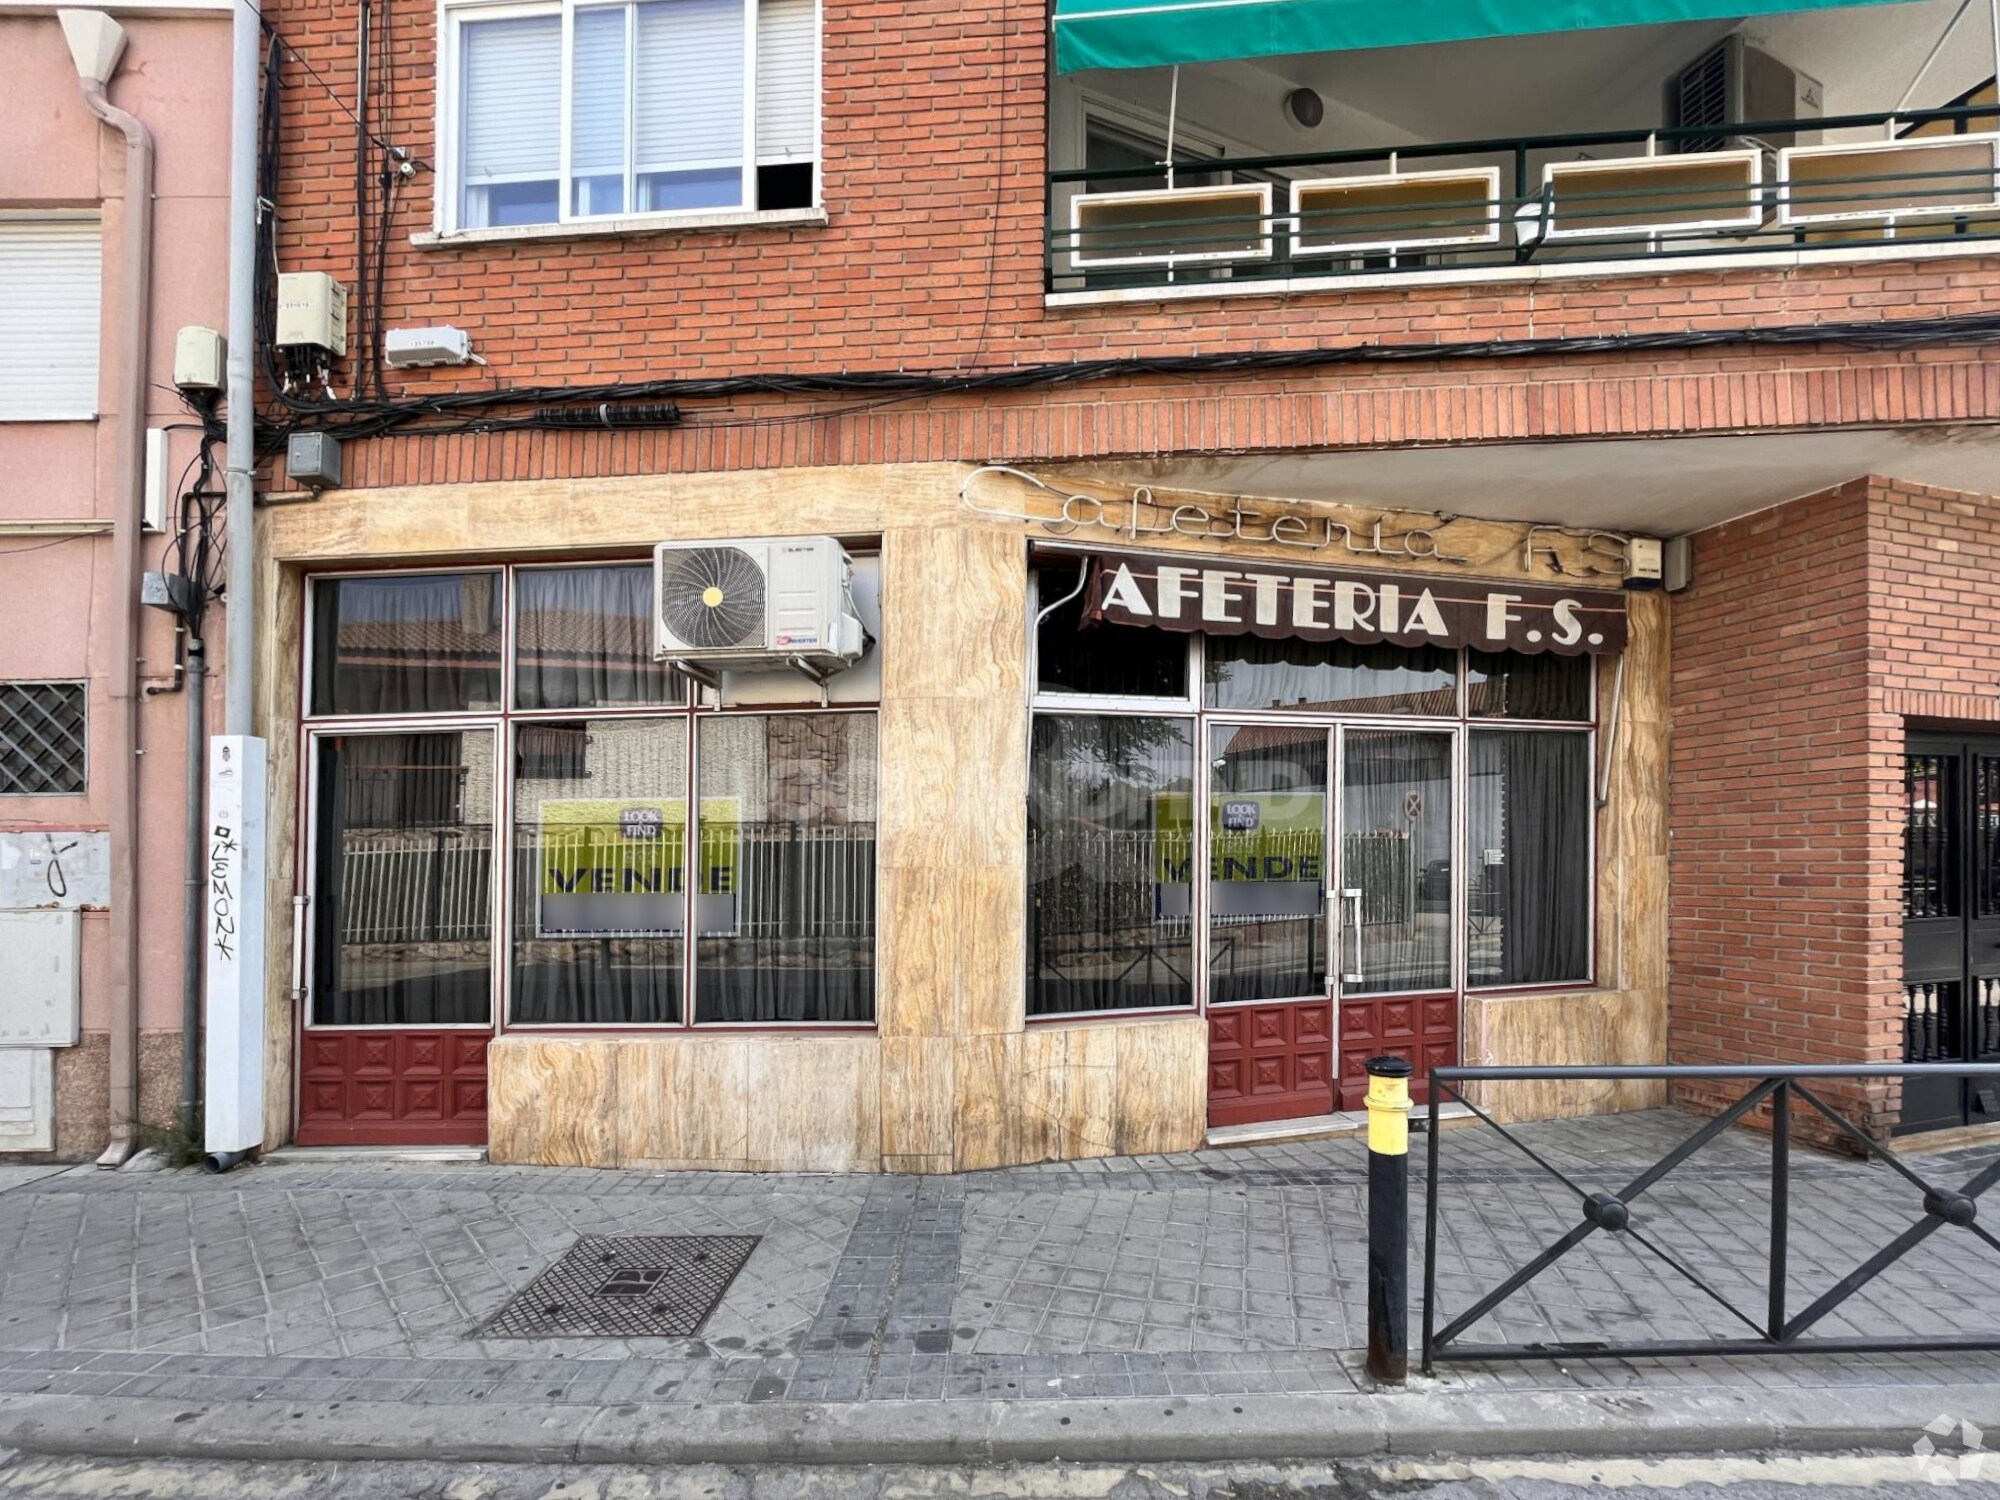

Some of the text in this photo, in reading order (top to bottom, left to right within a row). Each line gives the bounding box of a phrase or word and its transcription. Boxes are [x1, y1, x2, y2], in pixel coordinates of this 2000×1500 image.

[1101, 562, 1604, 646] AFETERIA F.S.
[1227, 804, 1256, 815] LOOK
[624, 810, 658, 821] LOOK
[1228, 817, 1254, 828] FIND
[549, 867, 733, 892] VENDE
